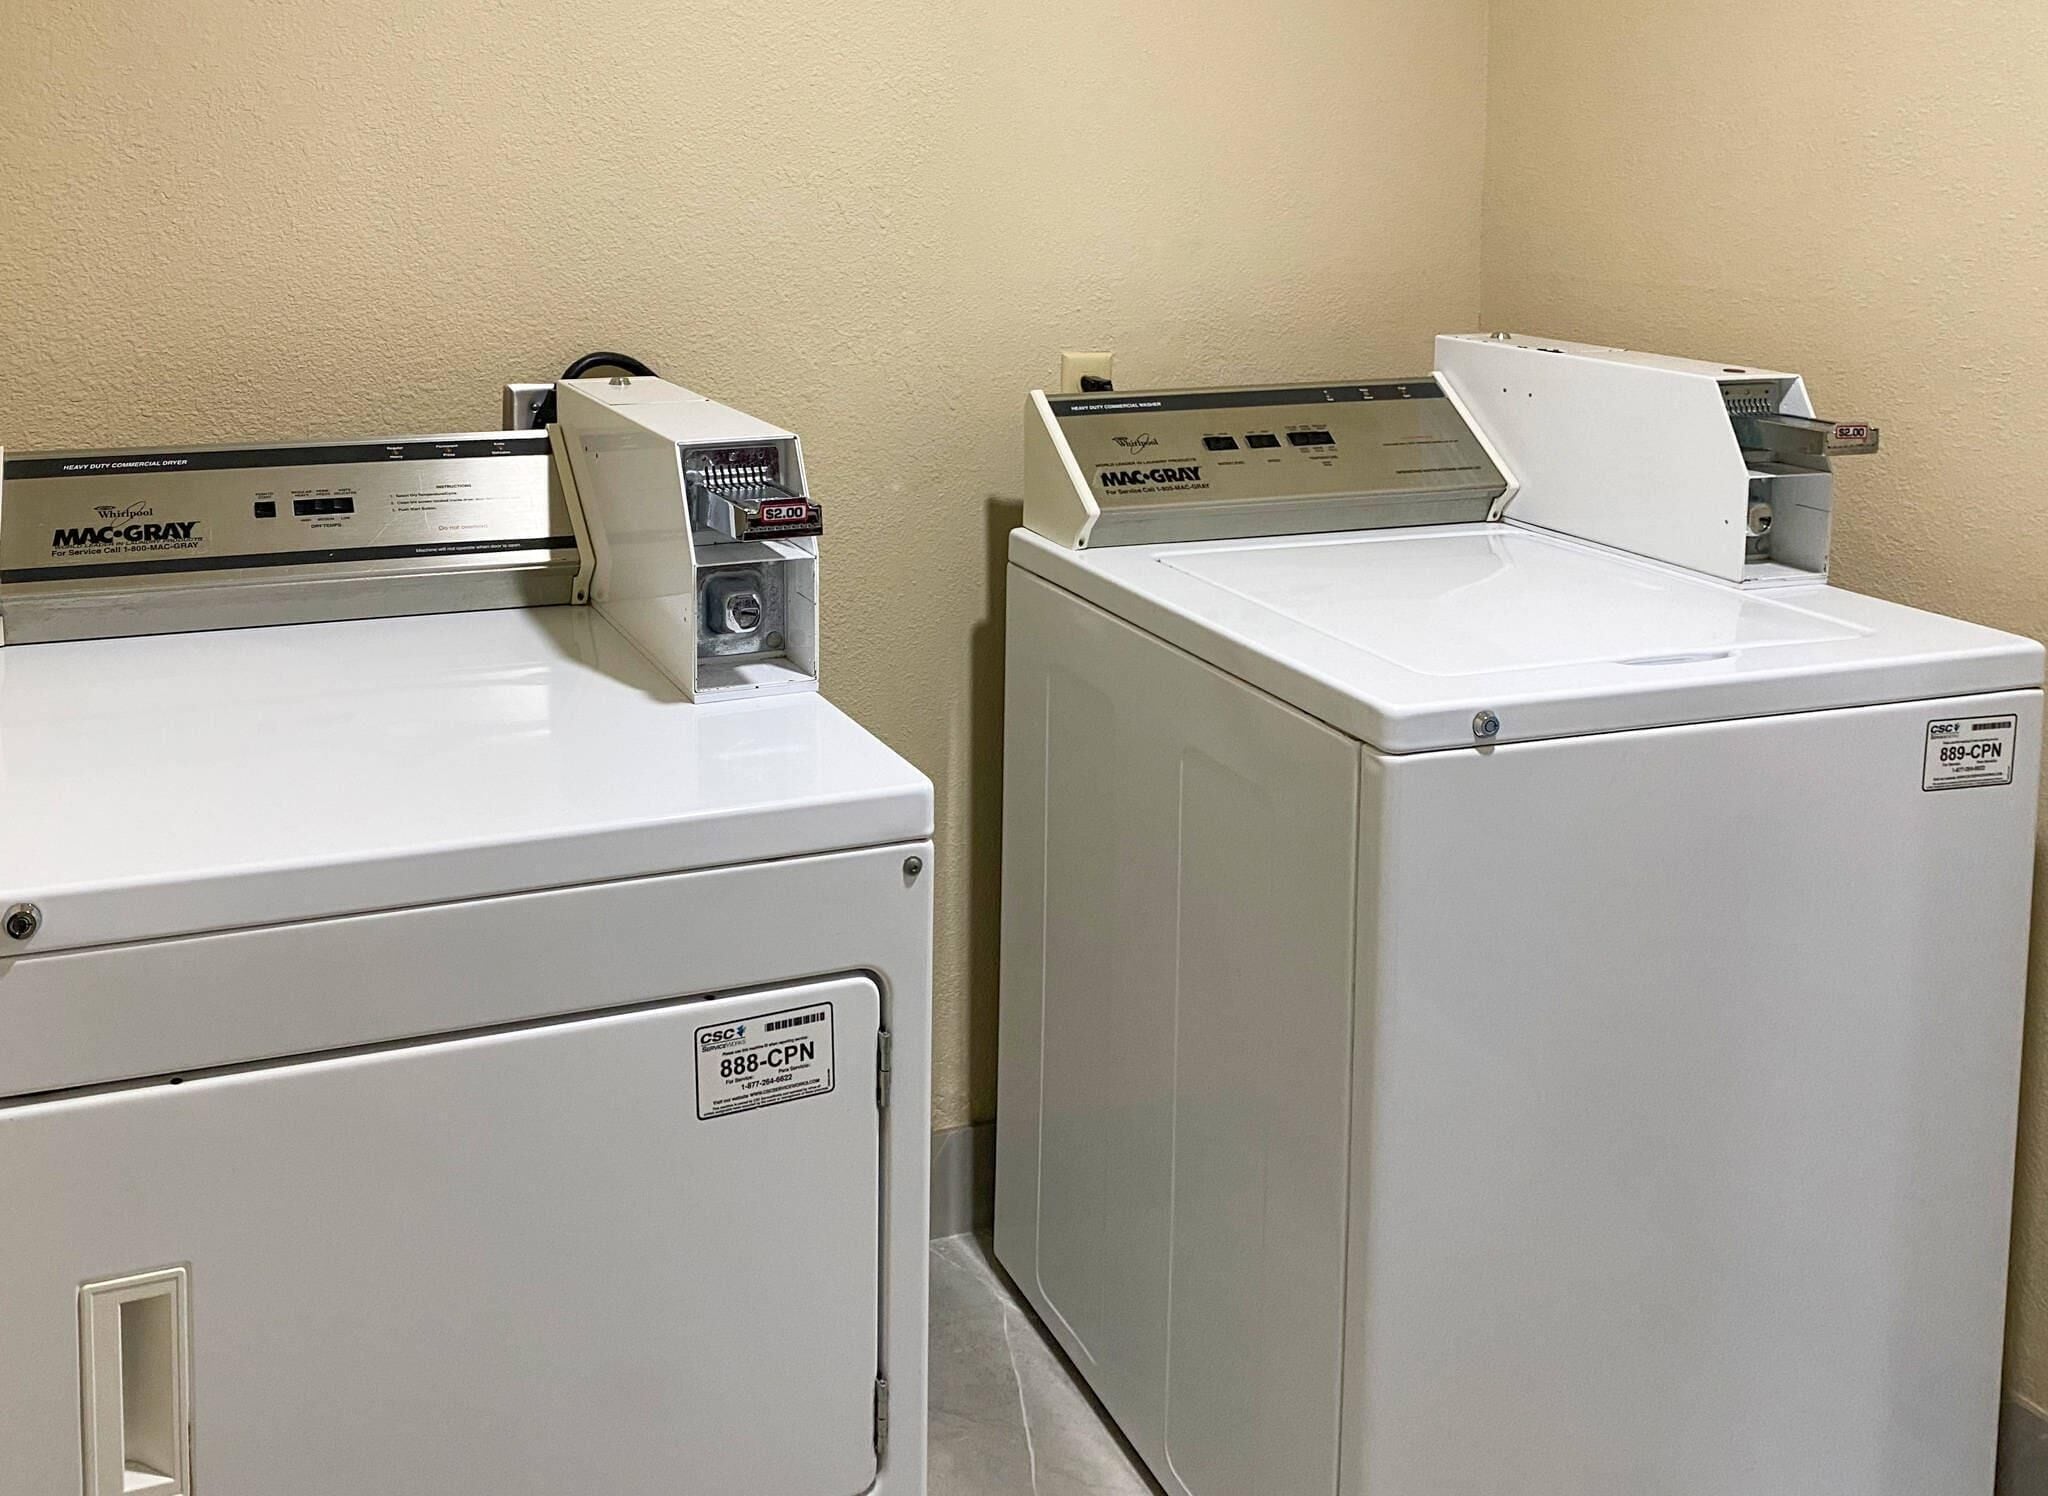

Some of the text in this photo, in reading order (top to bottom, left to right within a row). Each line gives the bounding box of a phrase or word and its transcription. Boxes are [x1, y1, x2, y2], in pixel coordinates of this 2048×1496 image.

[1838, 428, 1865, 436] $2.00
[1114, 438, 1159, 449] Whirlpool
[111, 460, 160, 468] COMMERCIAL
[98, 508, 153, 520] Whirlpool
[766, 507, 803, 519] $2.00
[52, 542, 199, 558] For Service Call 1-800-MAC-GRAY
[1930, 724, 1953, 734] CSC
[1940, 742, 2002, 762] 889-CPN
[700, 1028, 735, 1044] CSC
[720, 1041, 814, 1078] 888-CPN
